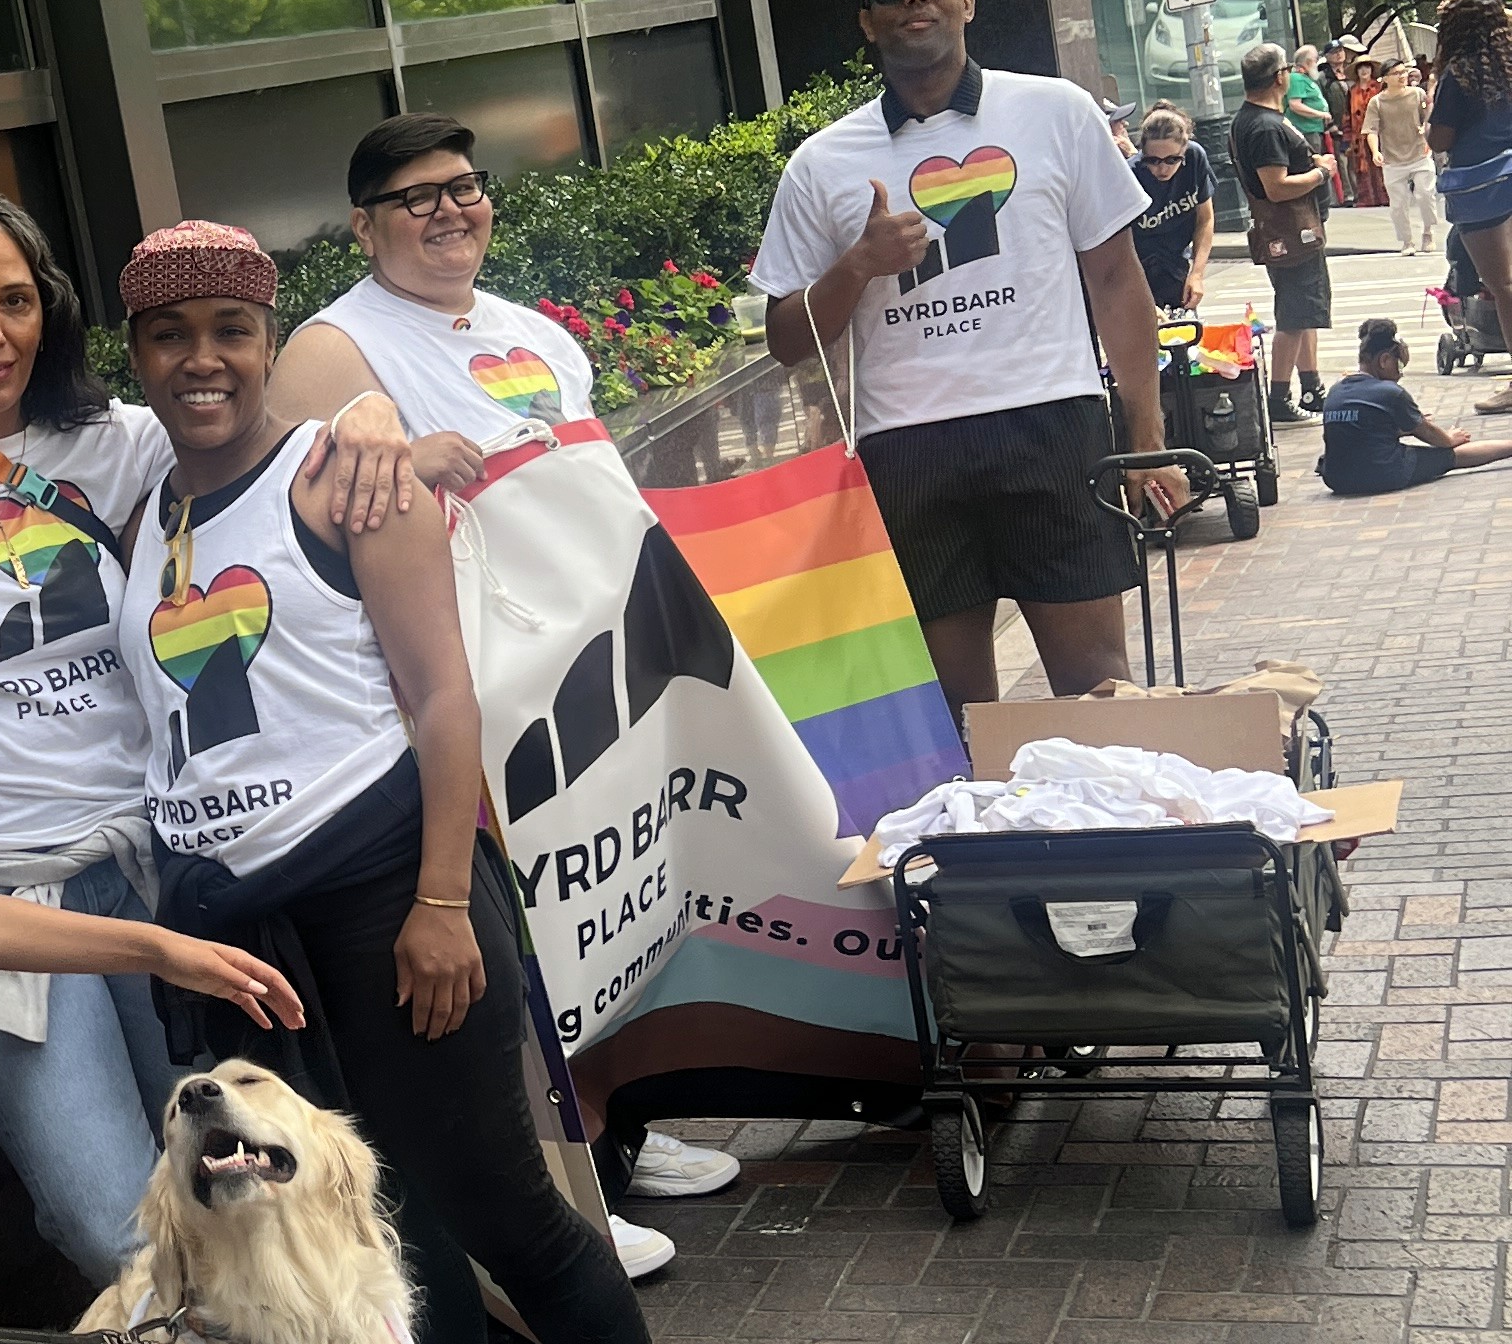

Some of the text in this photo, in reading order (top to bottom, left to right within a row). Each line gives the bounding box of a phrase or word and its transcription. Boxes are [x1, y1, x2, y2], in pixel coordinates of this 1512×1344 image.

[884, 286, 1016, 326] BYRD BARR
[923, 317, 983, 340] PLACE
[43, 648, 121, 693] BARR
[16, 693, 98, 720] PLACE
[199, 778, 294, 821] BARR
[170, 825, 246, 851] PLACE
[510, 766, 748, 909] YRD BARR
[577, 858, 668, 960] PLACE
[593, 890, 808, 1014] communities.
